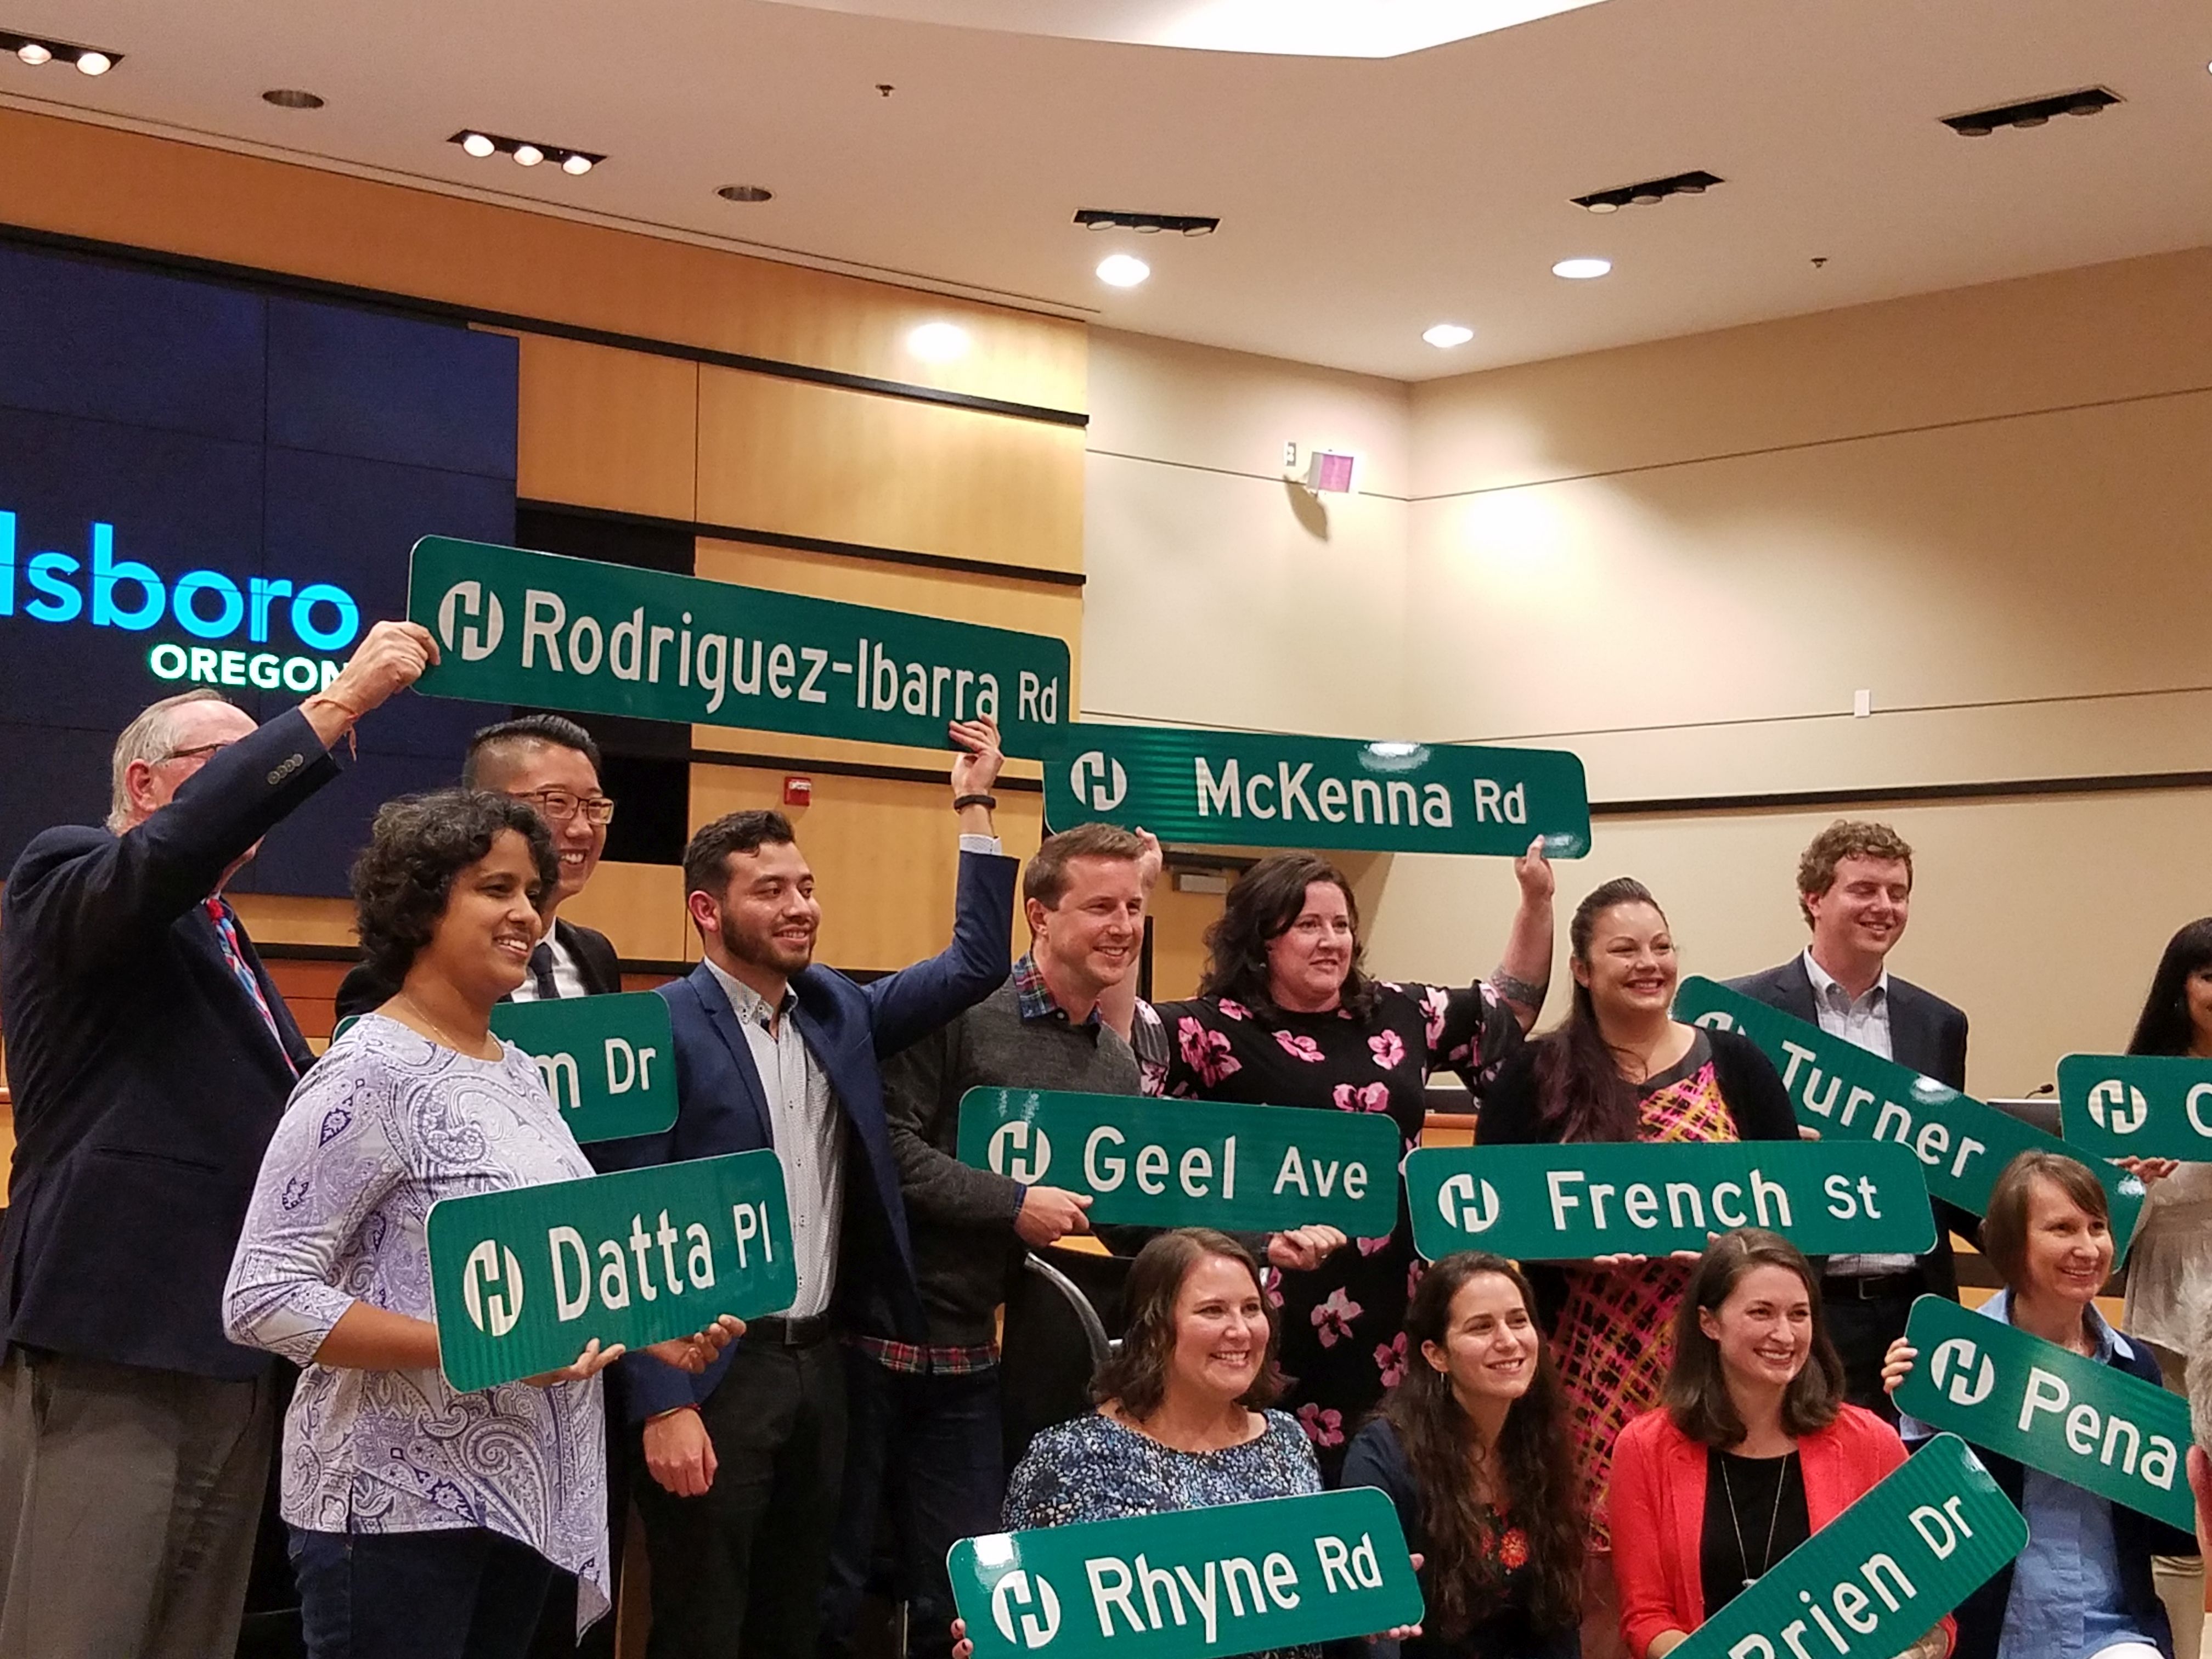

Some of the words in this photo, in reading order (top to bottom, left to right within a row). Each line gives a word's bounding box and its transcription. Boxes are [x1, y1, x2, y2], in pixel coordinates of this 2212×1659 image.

[0, 511, 359, 650] lsboro
[522, 589, 1000, 725] Rodriguez-Ibarra
[1019, 670, 1058, 724] Rd
[1195, 757, 1453, 827] McKenna
[1474, 779, 1527, 824] Rd
[605, 1037, 657, 1094] Dr
[1782, 1040, 1986, 1178] Turner
[1084, 1125, 1235, 1199] Geel
[1273, 1146, 1368, 1200] Ave
[1547, 1169, 1792, 1230] French
[1824, 1175, 1881, 1219] St
[548, 1209, 715, 1323] Datta
[733, 1200, 774, 1268] Pl
[2018, 1367, 2177, 1491] Pena
[1908, 1496, 1973, 1561] Dr
[1085, 1552, 1300, 1644] Rhyne
[1314, 1532, 1384, 1594] Rd
